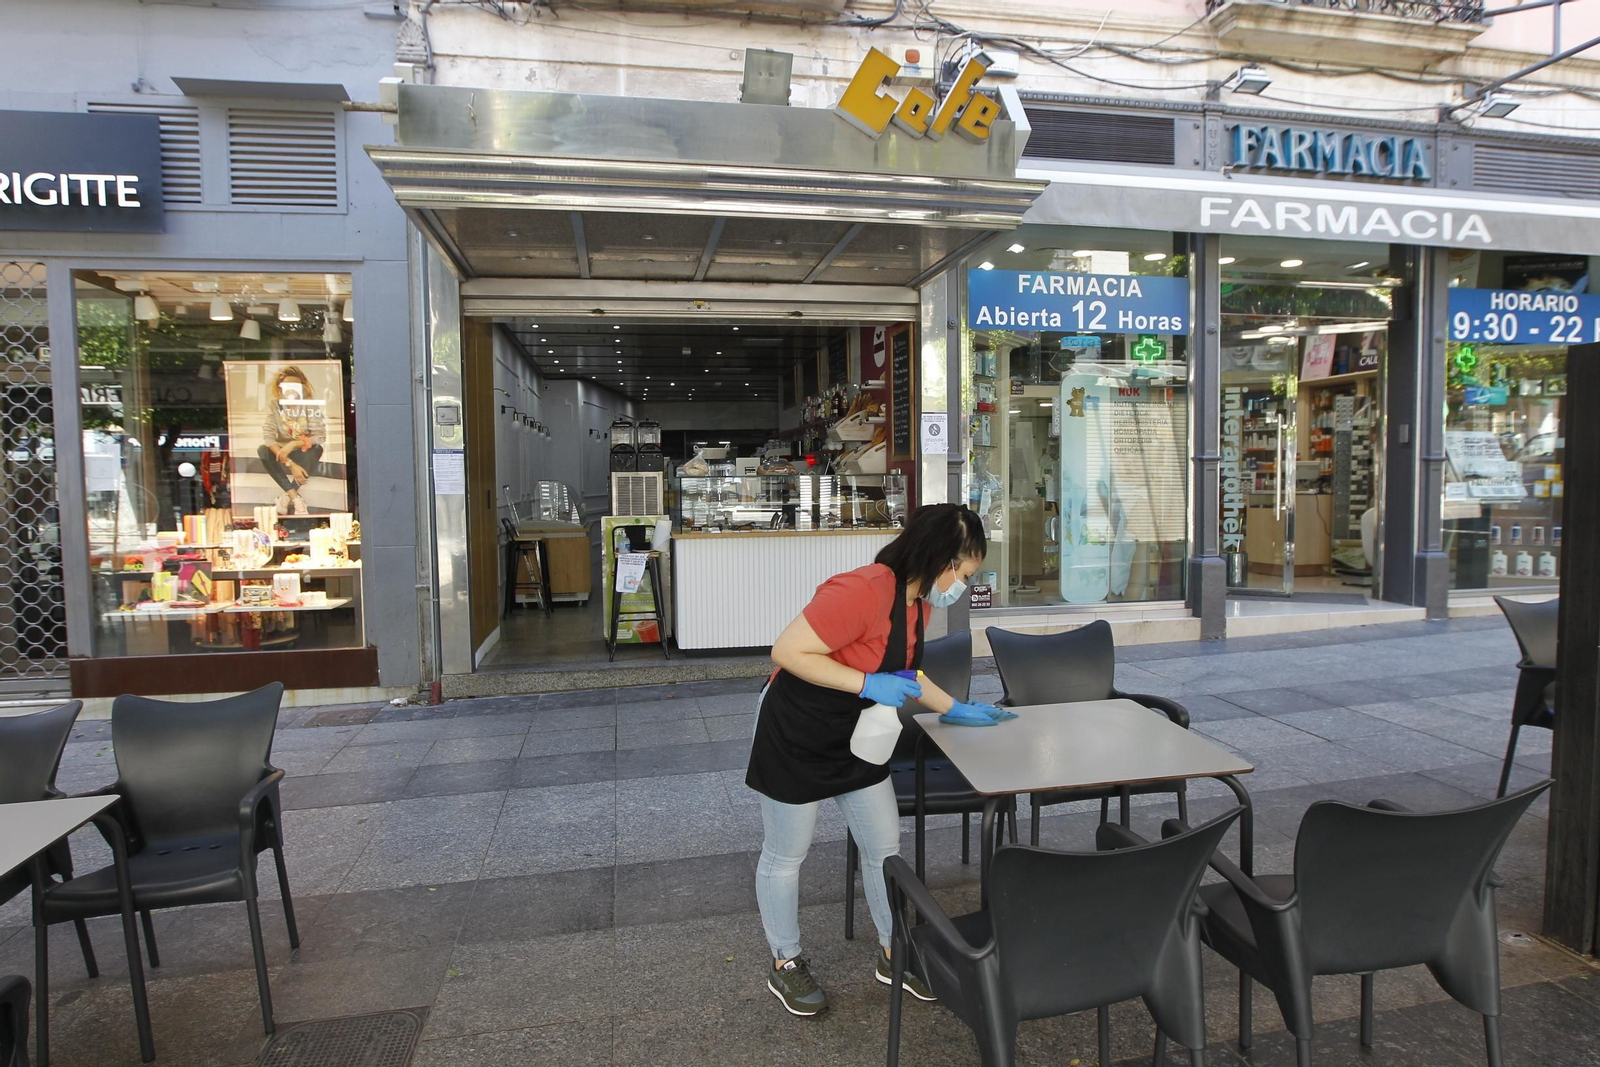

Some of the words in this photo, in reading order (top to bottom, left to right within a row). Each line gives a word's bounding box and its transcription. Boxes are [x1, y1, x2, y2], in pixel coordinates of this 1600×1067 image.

[1231, 123, 1433, 181] FARMACIA
[1200, 197, 1492, 243] FARMACIA
[1018, 274, 1143, 298] FARMACIA
[975, 306, 1062, 327] Abierta
[1071, 300, 1107, 330] 12
[1118, 310, 1183, 331] Horas
[1490, 292, 1579, 313] HORARIO
[1453, 311, 1518, 341] 9:30
[1548, 315, 1583, 343] 22
[1118, 387, 1140, 397] NUK
[1220, 386, 1249, 549] interapothek
